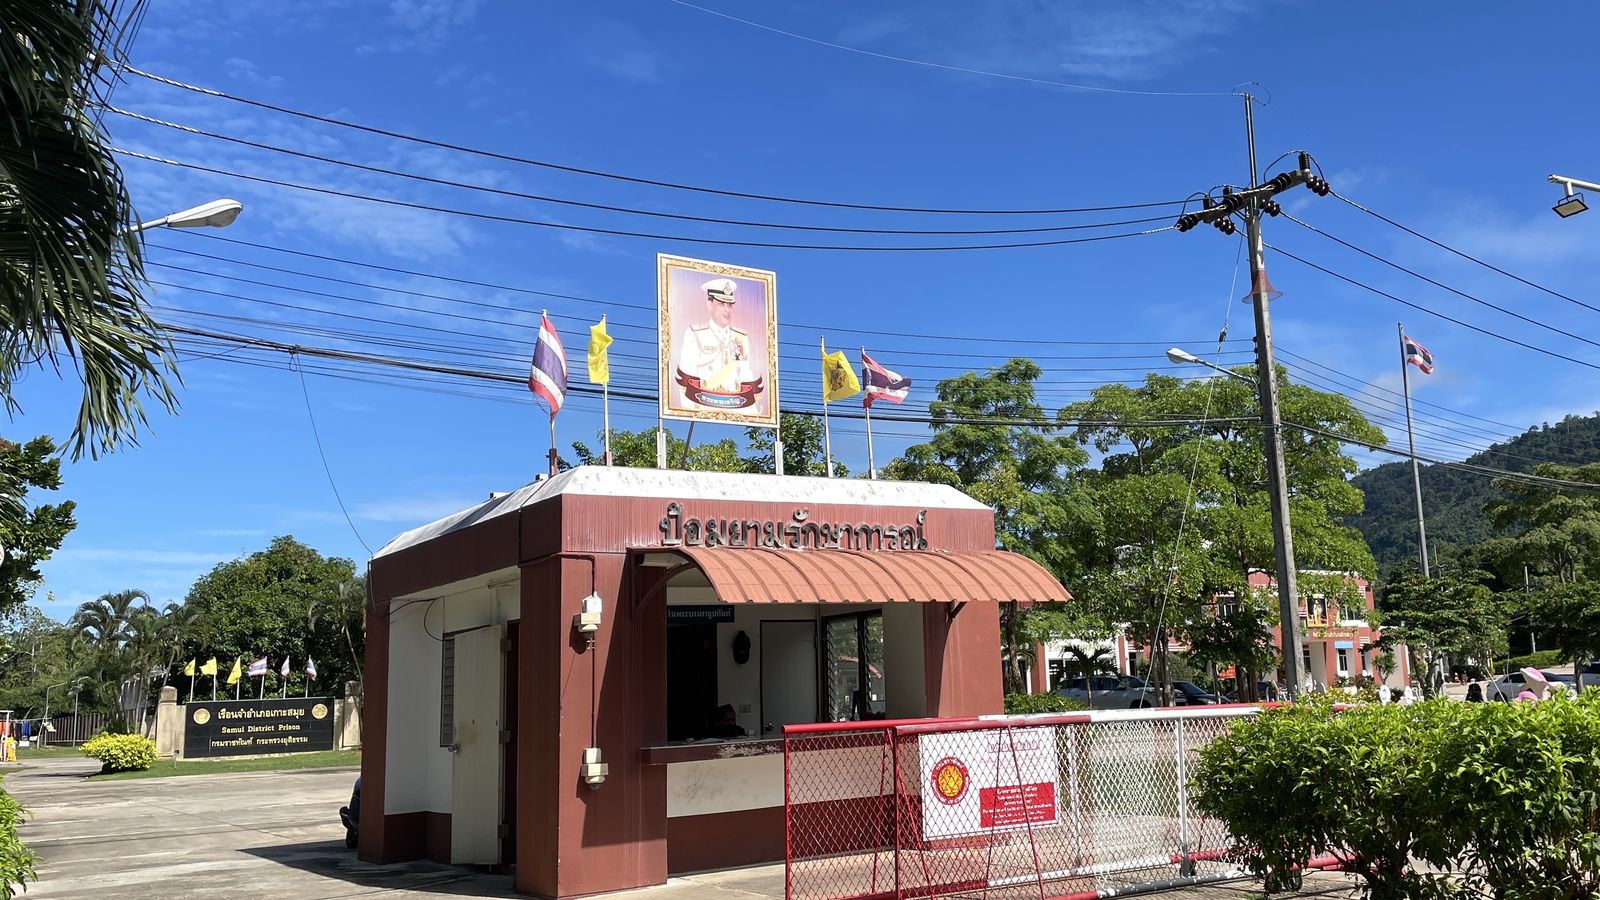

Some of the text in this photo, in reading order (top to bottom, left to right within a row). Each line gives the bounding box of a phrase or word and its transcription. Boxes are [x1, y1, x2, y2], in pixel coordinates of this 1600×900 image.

[659, 503, 928, 550] ป้อมยามรักษาการณ์
[218, 708, 305, 720] เรือนจำอำเภอเกาะสมุย
[247, 724, 274, 732] District
[278, 723, 300, 731] Prison
